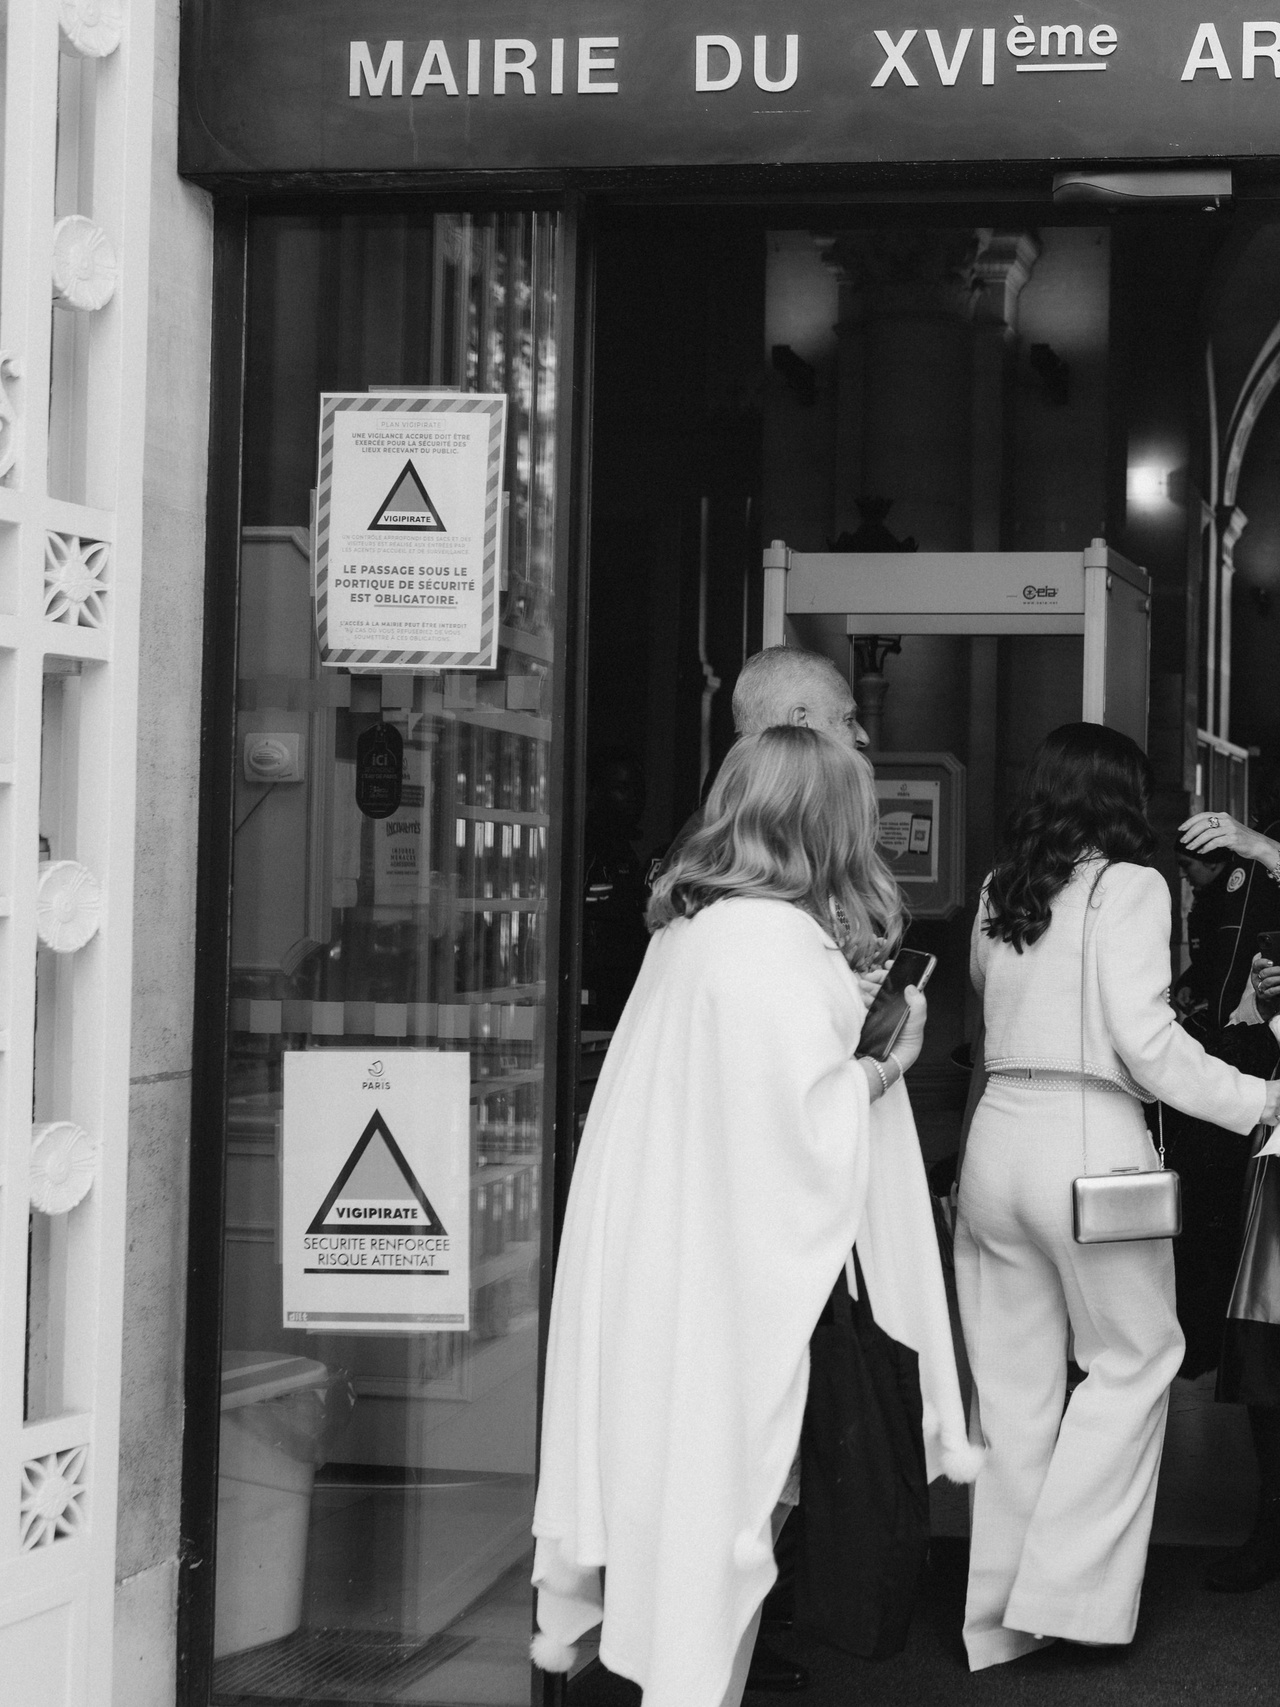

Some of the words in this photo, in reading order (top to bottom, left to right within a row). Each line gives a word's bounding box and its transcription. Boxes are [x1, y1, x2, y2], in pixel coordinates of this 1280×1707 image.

[348, 36, 620, 97] MAIRIE
[694, 33, 799, 93] DU
[870, 14, 1119, 88] XVIème
[401, 421, 442, 429] VIGIPIRATE
[453, 432, 471, 440] ÊTRE
[355, 438, 385, 446] EXERCÉE
[418, 439, 451, 447] SÉCURITÉ
[383, 515, 432, 523] VIGIPIRATE
[343, 564, 357, 574] LE
[360, 565, 415, 575] PASSAGE
[418, 566, 451, 576] SOUS
[454, 567, 468, 576] LE
[335, 578, 395, 590] PORTIQUE
[398, 580, 414, 589] DE
[418, 578, 476, 591] SÉCURITÉ
[350, 593, 371, 603] EST
[374, 593, 459, 605] OBLIGATOIRE.
[362, 1081, 391, 1090] PARIS
[336, 1207, 418, 1219] VIGIPIRATE
[303, 1237, 366, 1251] SECURITE
[370, 1238, 451, 1252] RENFORCEE
[318, 1253, 368, 1267] RISQUE
[371, 1254, 436, 1267] ATTENTAT
